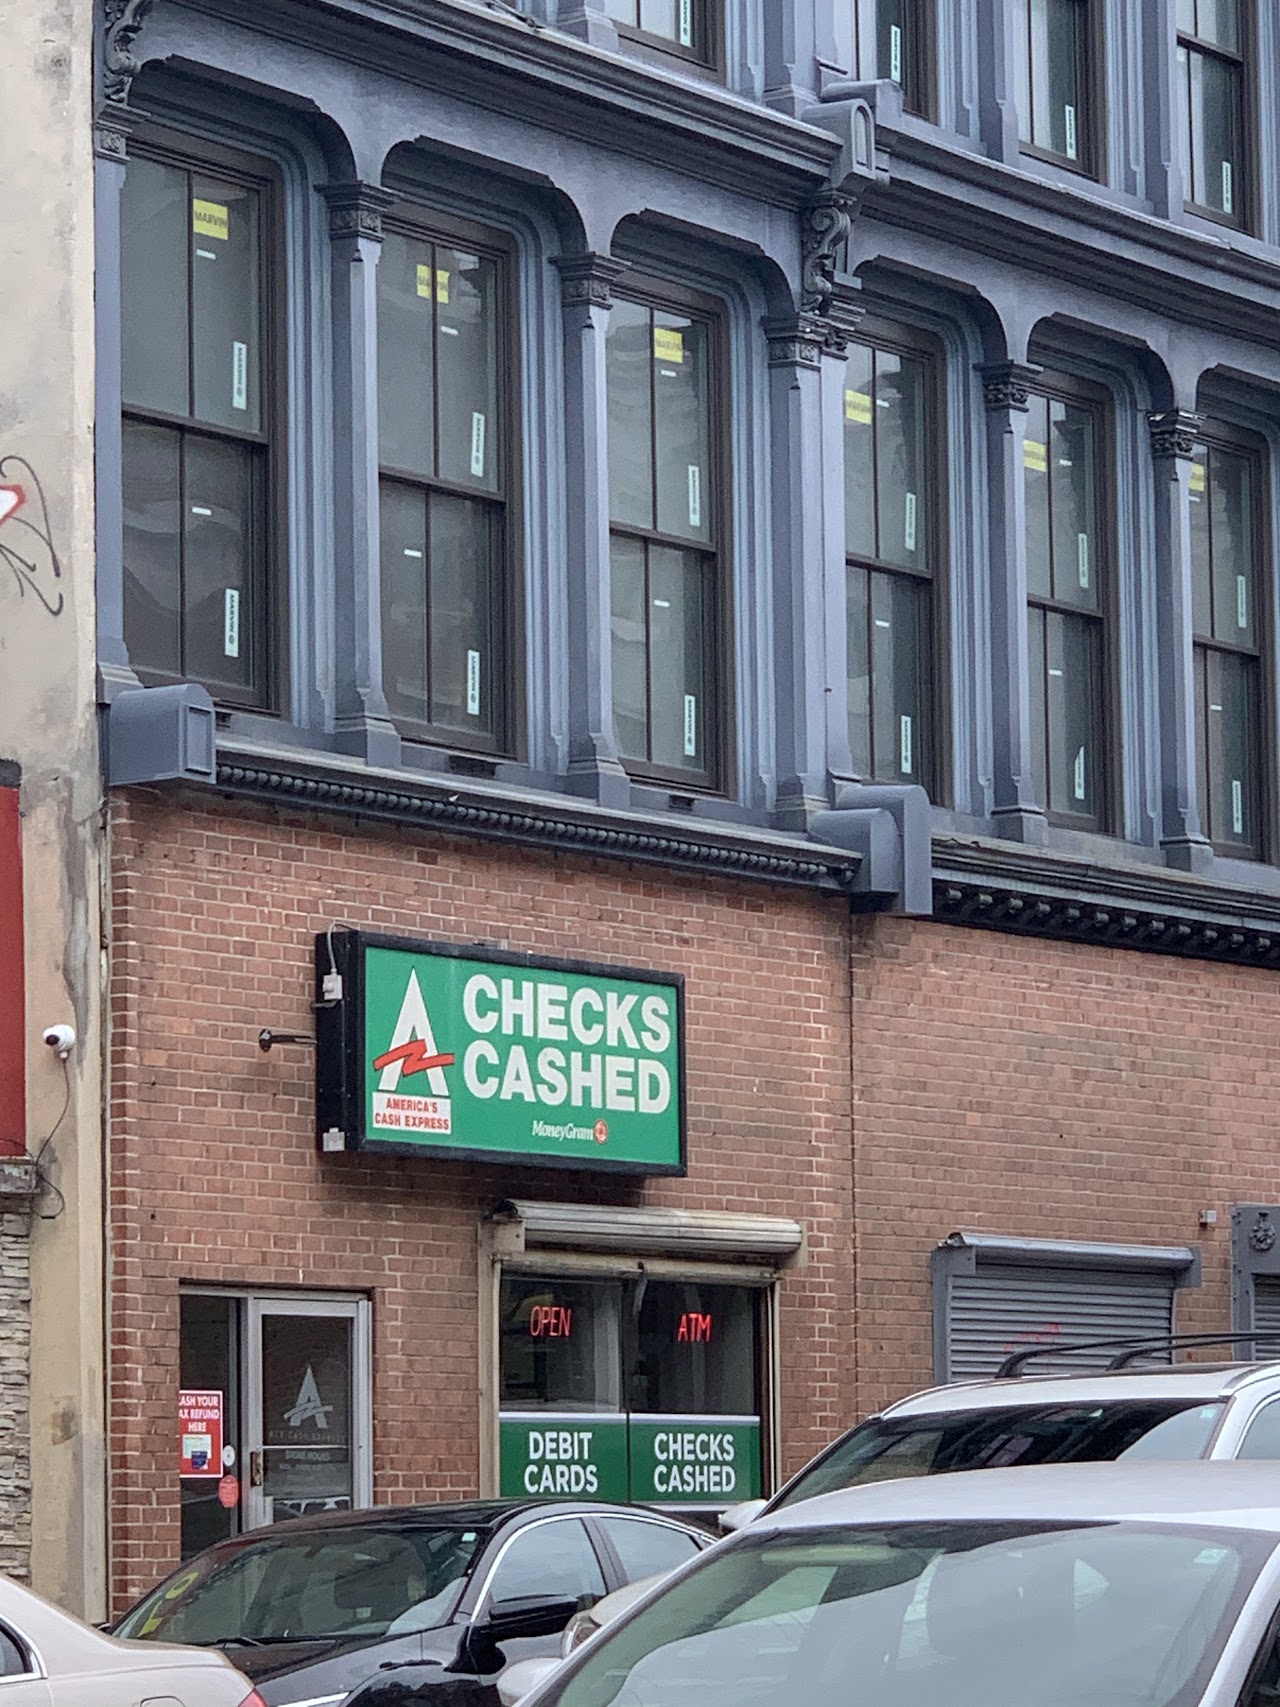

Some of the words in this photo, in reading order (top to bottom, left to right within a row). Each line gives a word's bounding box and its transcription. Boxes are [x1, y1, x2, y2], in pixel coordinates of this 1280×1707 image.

[194, 211, 227, 228] MARVIN
[463, 974, 671, 1053] CHECKS
[463, 1039, 671, 1115] CASHED
[386, 1098, 438, 1113] AMERICA'S
[375, 1112, 401, 1126] CASH
[404, 1114, 450, 1131] EXPRESS
[532, 1120, 594, 1141] MoneyGram
[529, 1306, 572, 1337] OPEN
[677, 1312, 713, 1342] ATM
[179, 1396, 196, 1407] ASH
[197, 1396, 219, 1407] YOUR
[190, 1409, 220, 1420] REFUND
[188, 1421, 207, 1432] HERE
[529, 1431, 593, 1460] DEBIT
[654, 1432, 735, 1462] CHECKS
[524, 1464, 598, 1493] CARDS
[653, 1464, 736, 1493] CASHED
